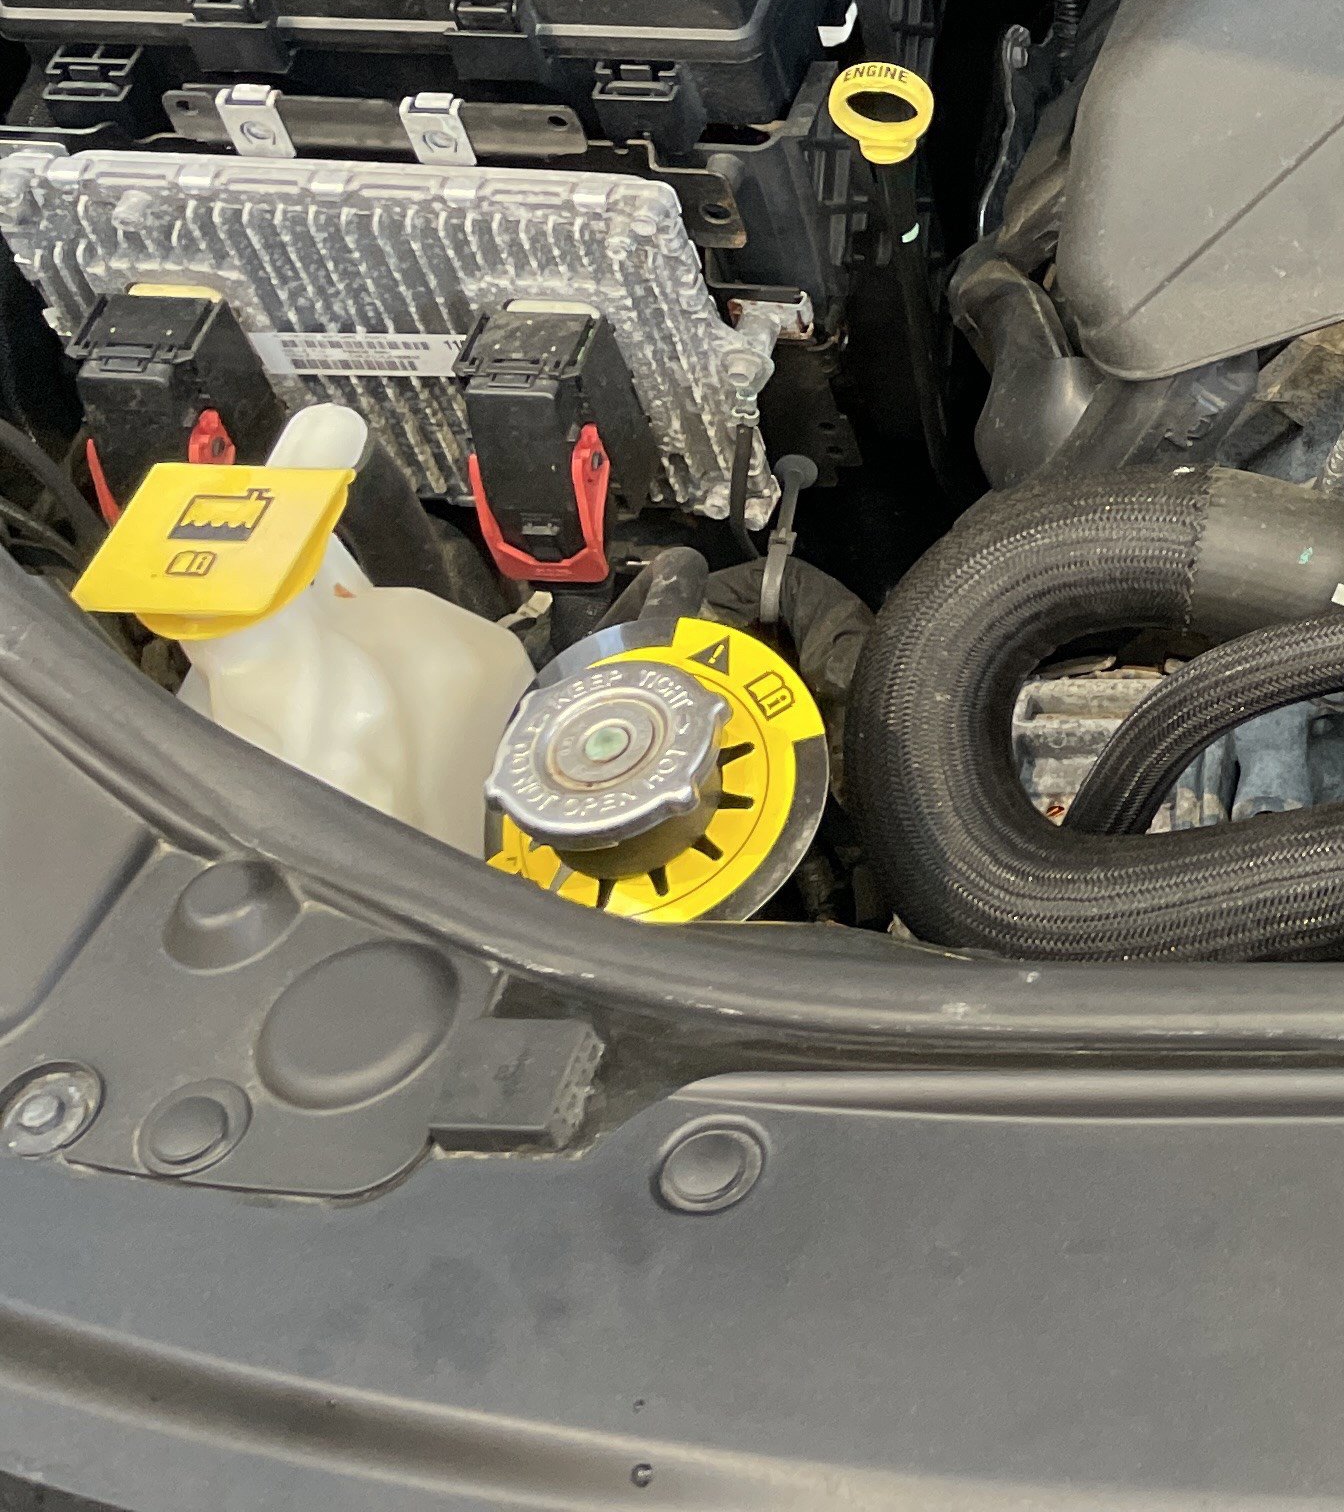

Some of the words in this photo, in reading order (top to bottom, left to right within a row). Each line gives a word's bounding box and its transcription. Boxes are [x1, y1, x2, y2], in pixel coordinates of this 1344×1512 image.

[842, 64, 910, 84] ENGINE
[552, 669, 624, 711] KEEP
[637, 669, 695, 711] TIGHT
[563, 790, 637, 817] OPEN
